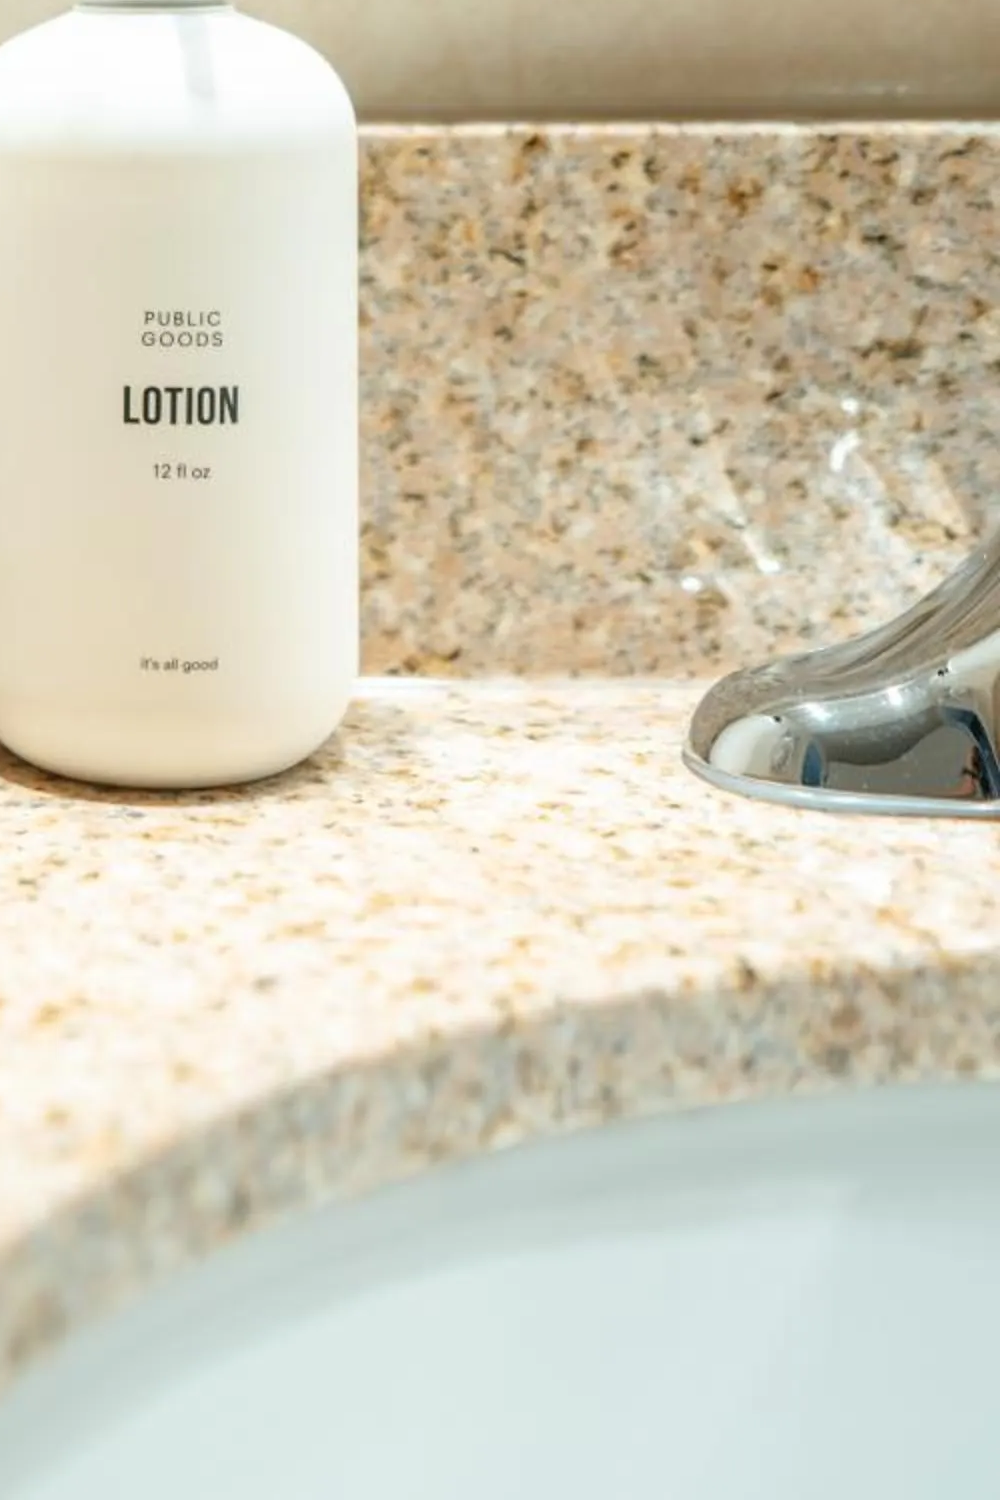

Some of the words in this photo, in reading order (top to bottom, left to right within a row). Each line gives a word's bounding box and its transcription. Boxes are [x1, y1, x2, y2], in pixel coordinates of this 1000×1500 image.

[143, 310, 221, 327] PUBLIC
[141, 331, 224, 348] GOODS
[122, 384, 240, 426] LOTION
[153, 463, 172, 480] 12
[176, 463, 187, 480] fl
[191, 467, 211, 480] oz
[163, 658, 179, 672] all
[182, 658, 219, 674] good
